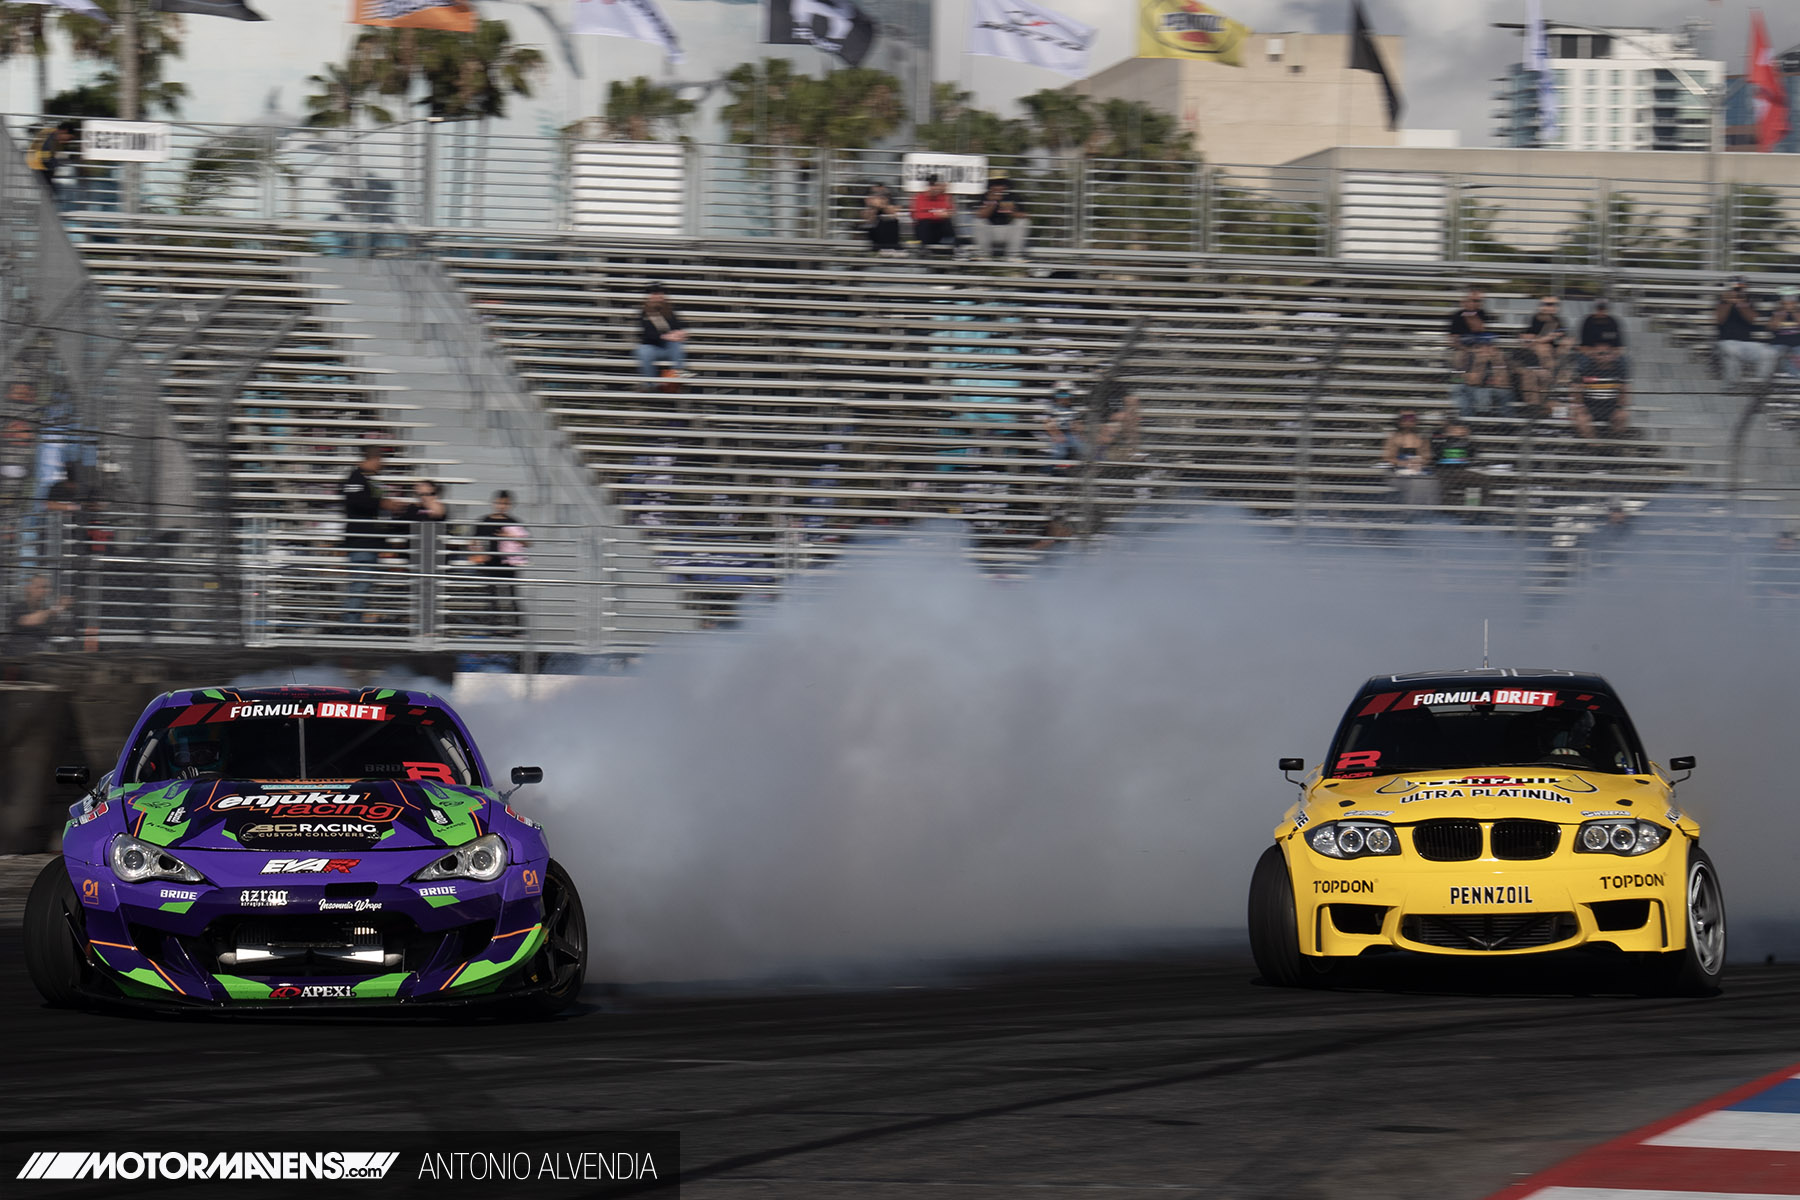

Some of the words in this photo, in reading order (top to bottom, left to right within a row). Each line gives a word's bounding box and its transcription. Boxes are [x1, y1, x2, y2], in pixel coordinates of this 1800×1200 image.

[1413, 691, 1490, 706] FORMULA
[1494, 690, 1554, 706] DRIFT
[230, 703, 315, 719] FORMULA
[319, 703, 383, 720] DRIFT
[217, 792, 361, 808] enjuku
[1400, 789, 1465, 804] ULTRA
[1471, 788, 1573, 804] PLATINUM
[272, 803, 394, 819] racing
[300, 823, 377, 833] RACING
[1313, 880, 1374, 893] TOPDON
[1600, 874, 1664, 889] TOPDON
[160, 889, 197, 900] BRIDE
[240, 889, 289, 906] azrag
[419, 886, 457, 896] BRIDE
[1449, 886, 1533, 905] PENNZOIL
[354, 898, 383, 911] Wraps
